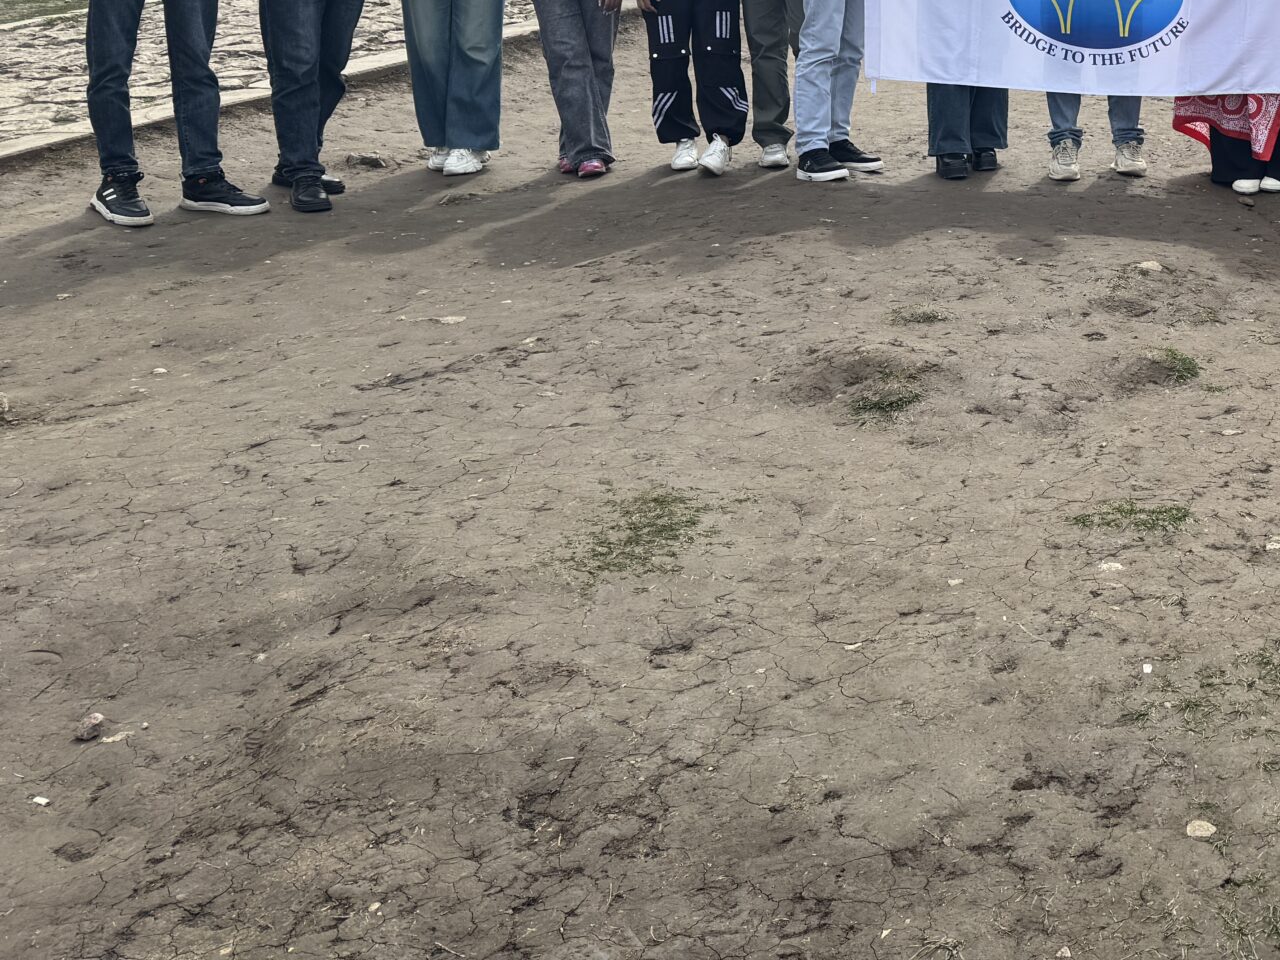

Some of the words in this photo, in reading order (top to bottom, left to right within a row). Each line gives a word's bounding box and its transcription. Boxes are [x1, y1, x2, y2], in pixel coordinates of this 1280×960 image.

[1000, 9, 1053, 57] BRIDGE
[1060, 47, 1085, 64] TO
[1088, 52, 1126, 66] THE
[1127, 16, 1190, 63] FUTURE
